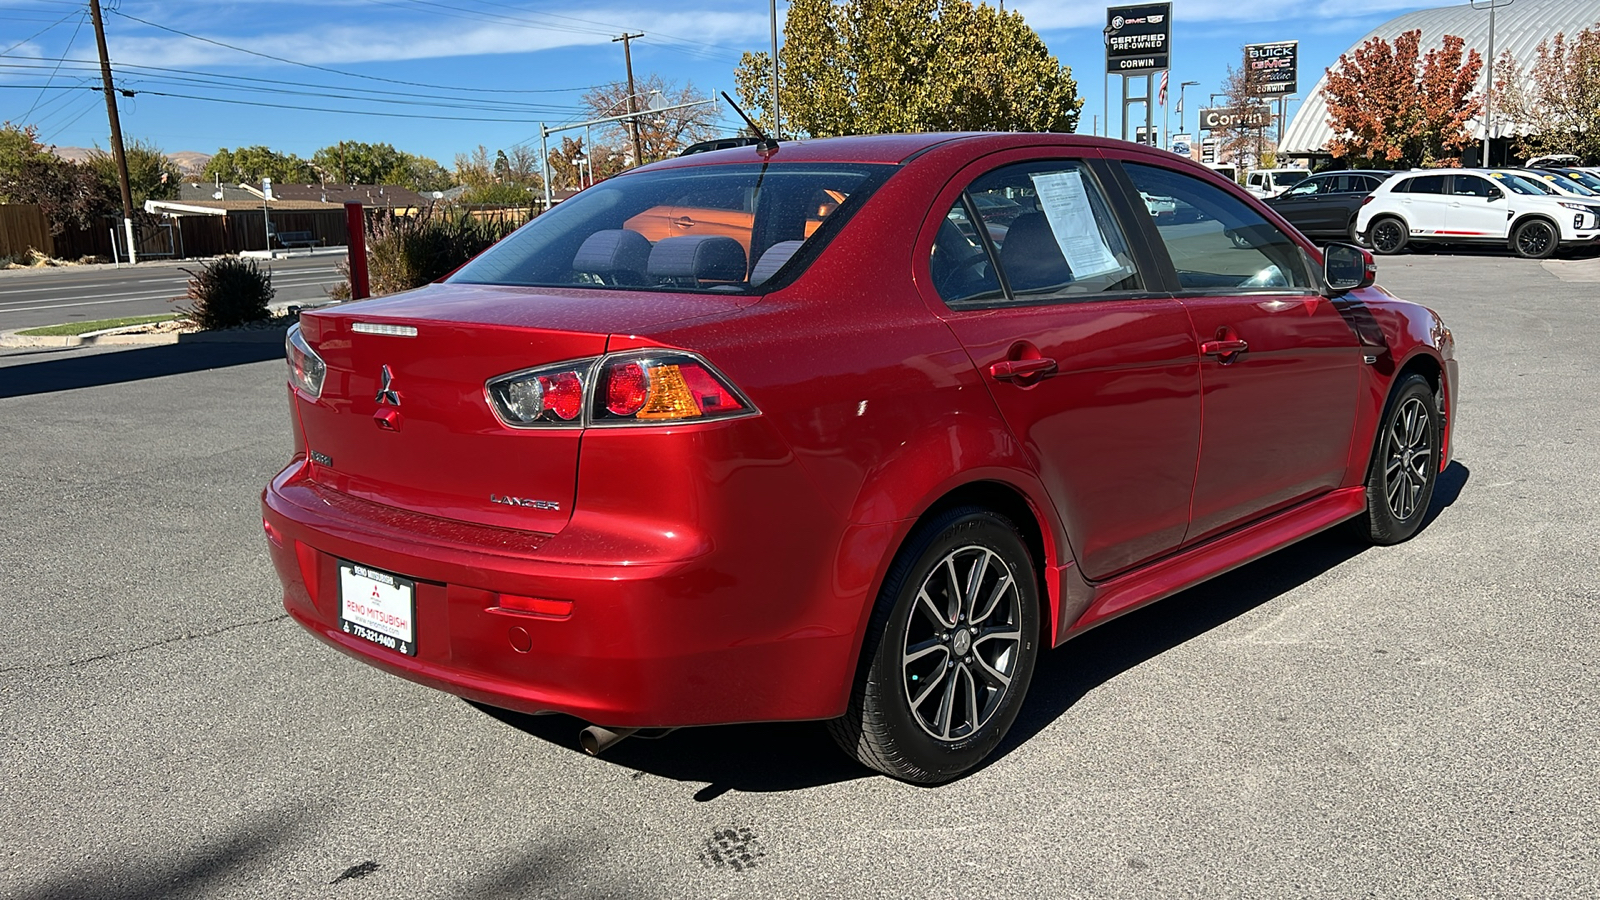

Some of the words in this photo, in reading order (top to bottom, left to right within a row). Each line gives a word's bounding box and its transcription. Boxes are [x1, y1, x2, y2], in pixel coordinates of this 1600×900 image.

[1110, 33, 1166, 44] CERTIFIED
[1113, 40, 1162, 51] PRE-OWNED
[1249, 47, 1293, 58] BUICK
[1120, 58, 1154, 69] CORWIN
[1251, 58, 1291, 69] GMC
[490, 493, 560, 511] LANCER
[346, 600, 365, 616] RENO
[366, 607, 408, 631] MITSUBISHI
[353, 624, 396, 649] 775-321-9400
